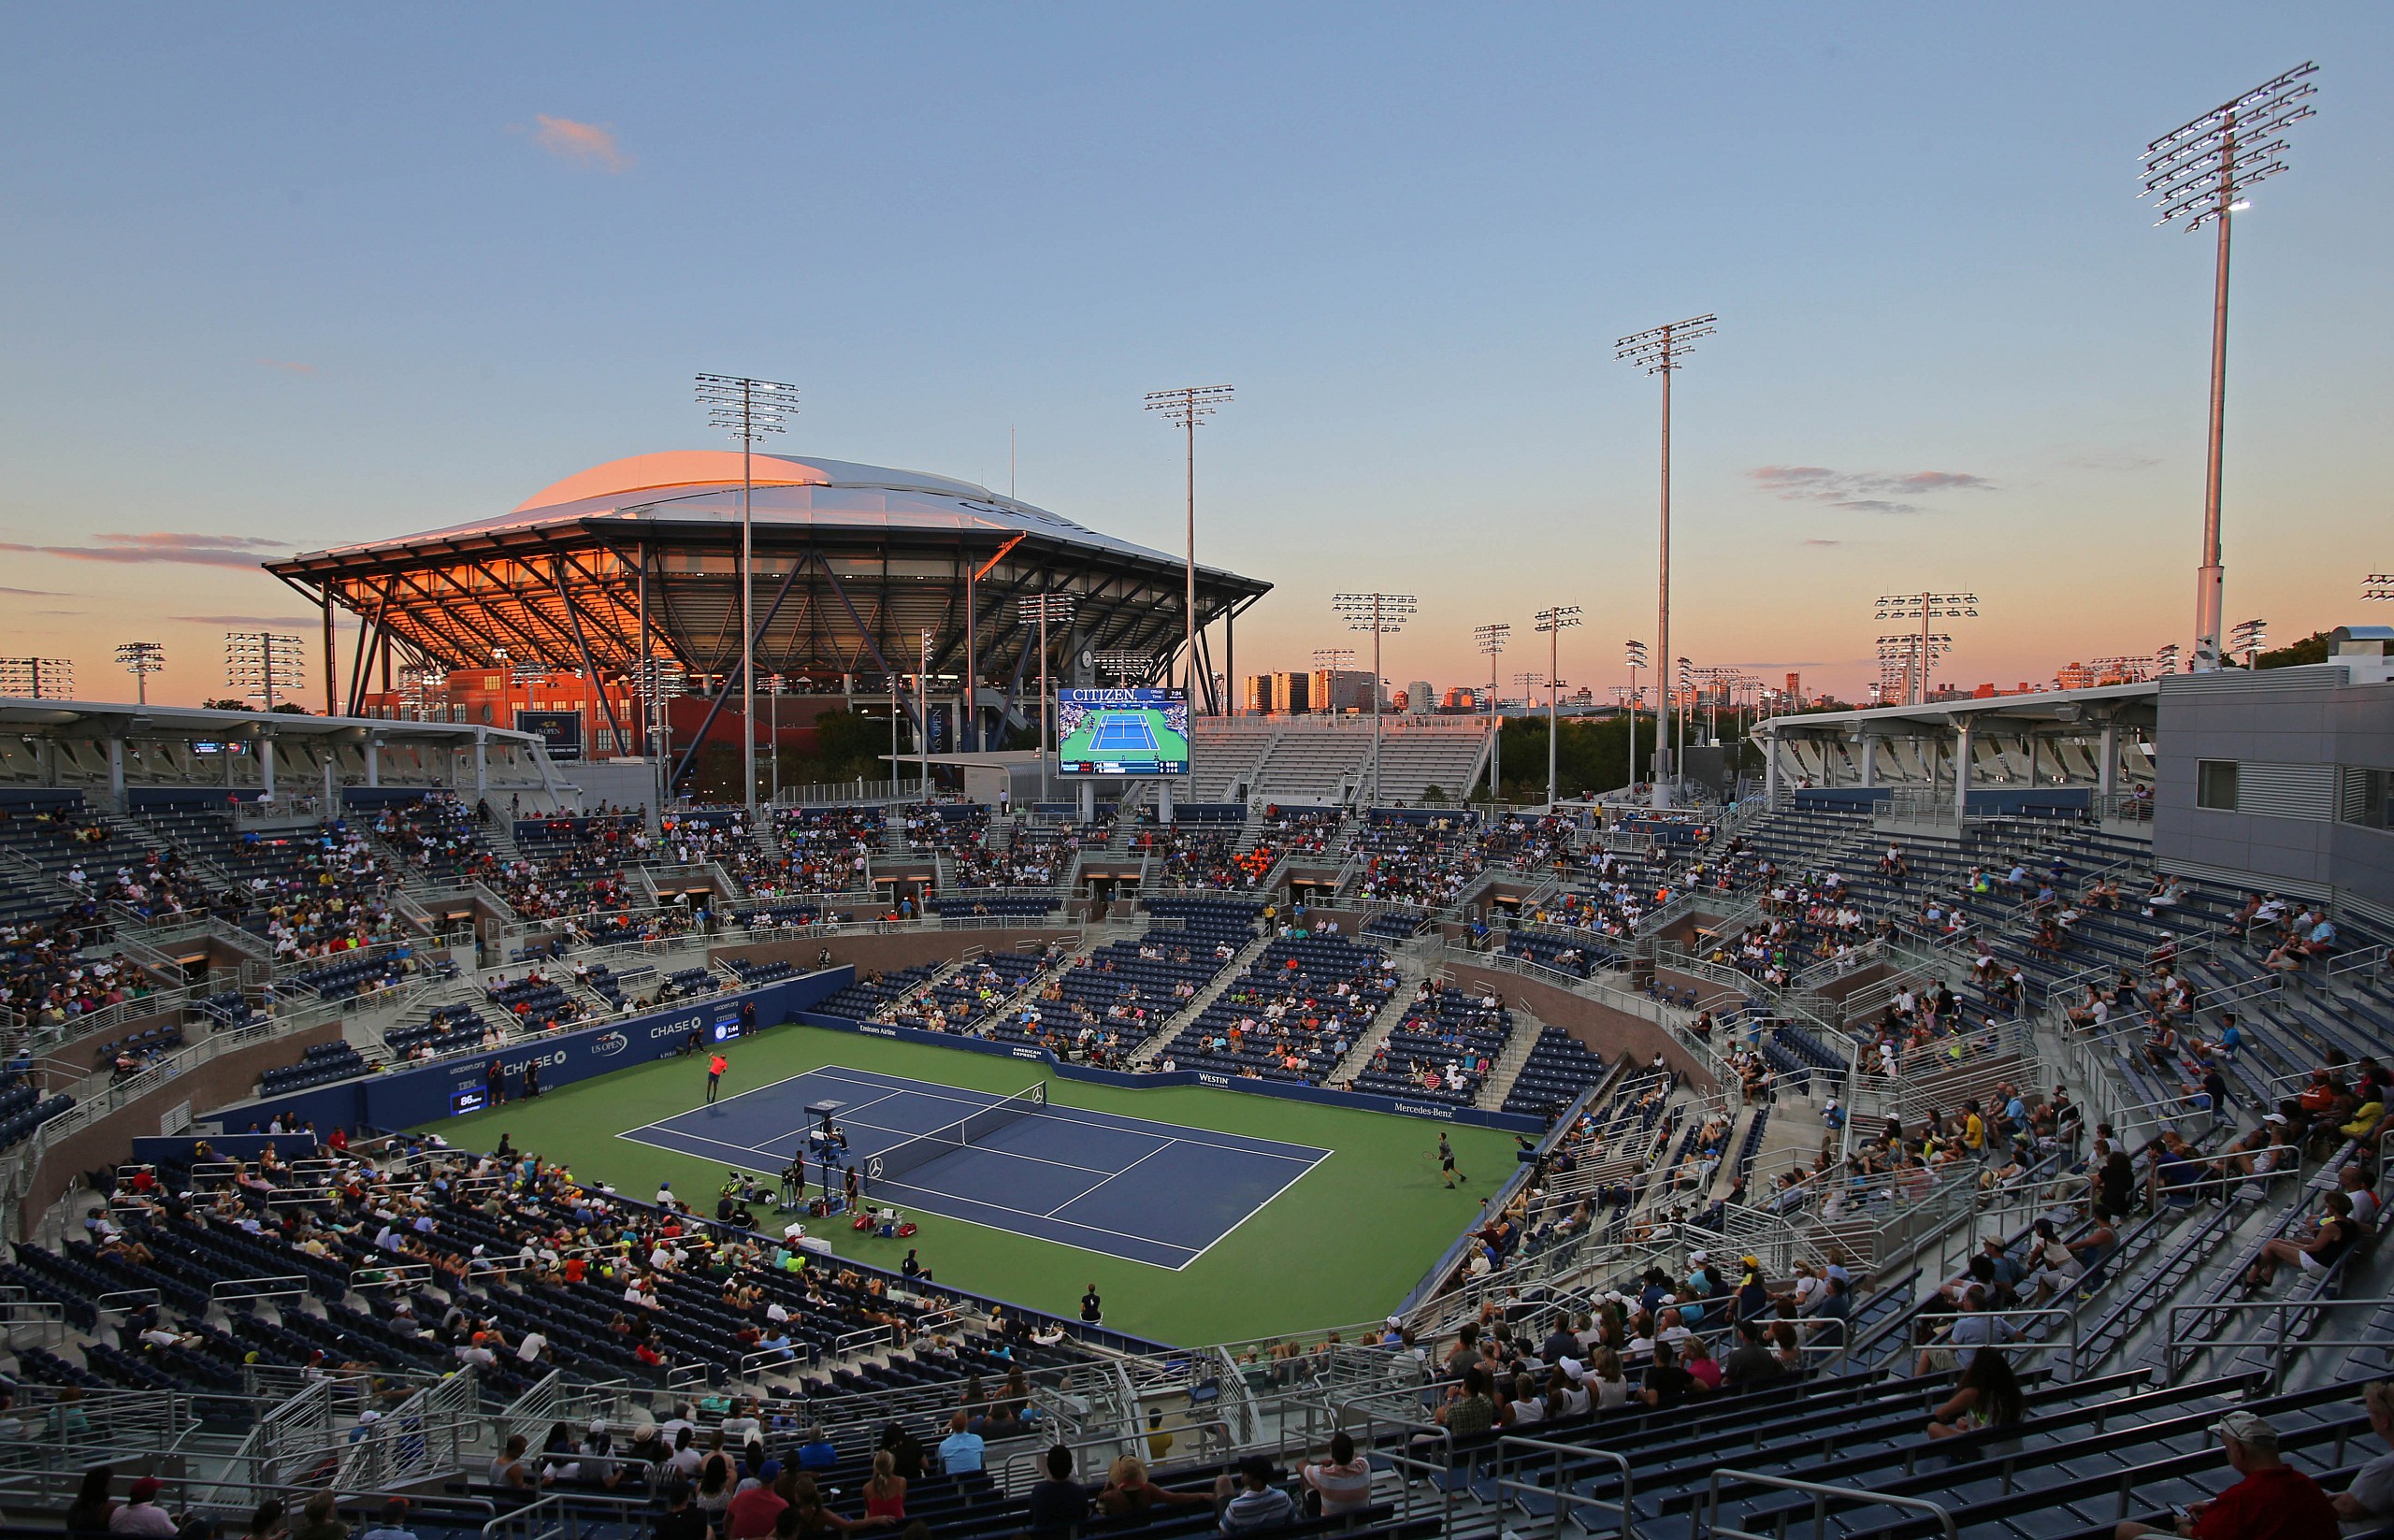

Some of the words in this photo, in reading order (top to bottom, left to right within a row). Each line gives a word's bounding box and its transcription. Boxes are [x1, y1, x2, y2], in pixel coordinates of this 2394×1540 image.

[1073, 688, 1135, 701] CITIZEN
[932, 709, 942, 737] OPEN
[714, 1000, 739, 1012] usopen.org
[716, 1013, 737, 1023] CITIZEN
[650, 1020, 690, 1039] CHASE
[859, 1025, 880, 1034] Emirates
[591, 1044, 601, 1054] US
[601, 1039, 624, 1051] OPEN
[1013, 1047, 1042, 1056] AMERICAN
[1013, 1051, 1037, 1059] EXPRESS
[450, 1061, 486, 1074] usopen.org
[1199, 1072, 1229, 1085] WESTIN
[458, 1079, 477, 1091] IBM
[460, 1095, 473, 1106] 86
[1394, 1102, 1453, 1118] Mercedes-Benz
